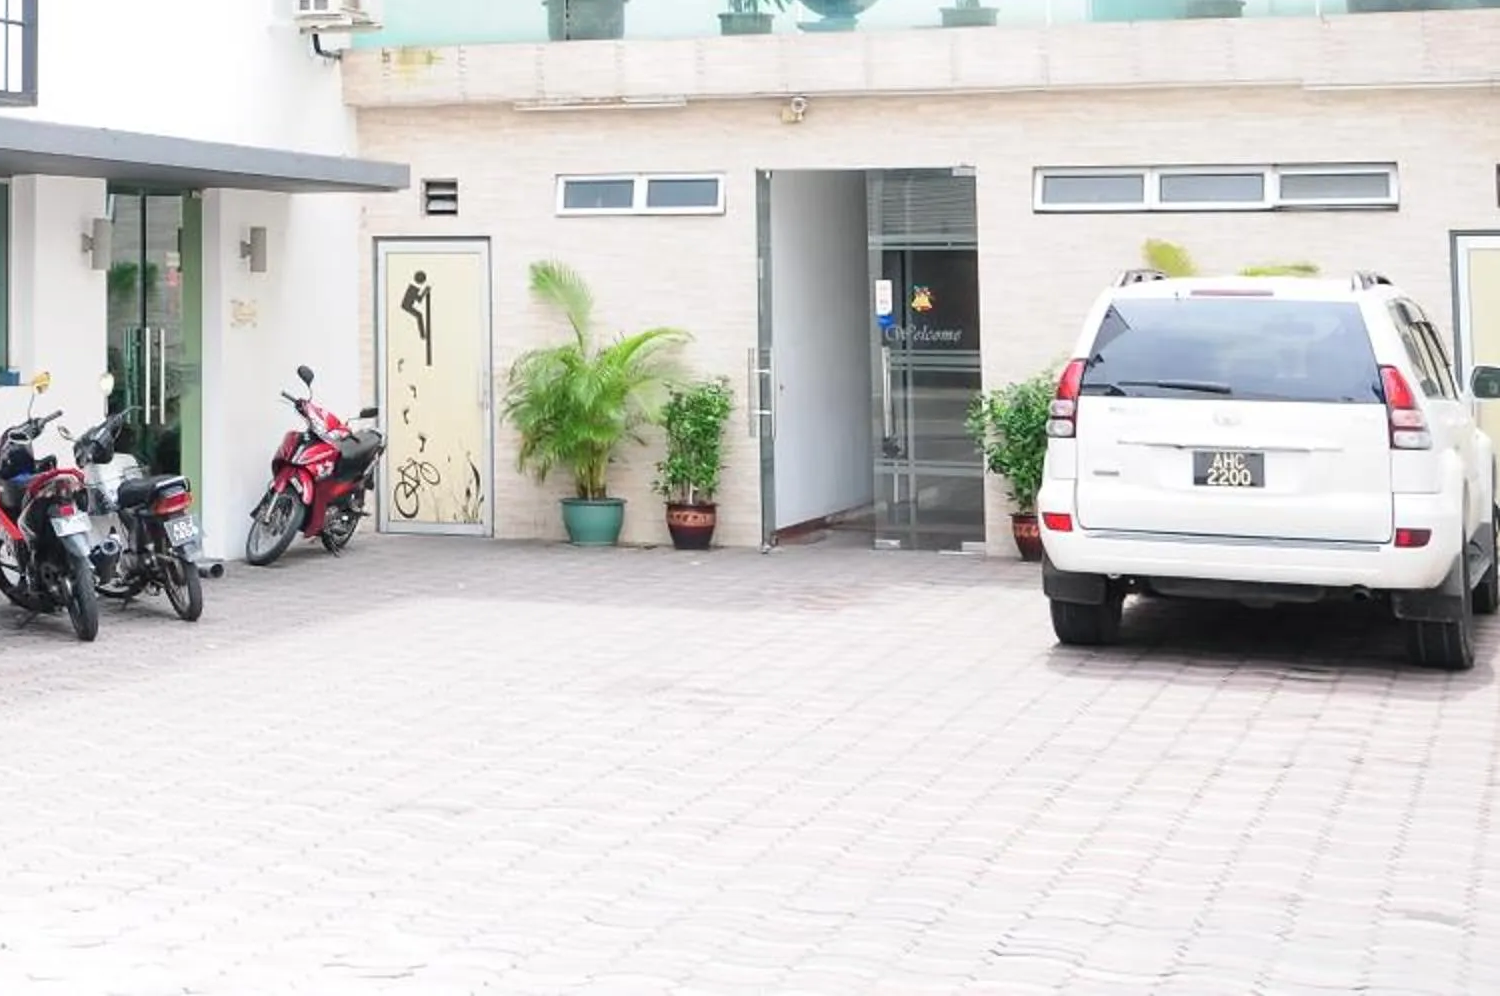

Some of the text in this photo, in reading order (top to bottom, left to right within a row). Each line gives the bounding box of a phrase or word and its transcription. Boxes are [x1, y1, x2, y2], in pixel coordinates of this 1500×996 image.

[884, 325, 962, 342] Welcome
[1213, 452, 1245, 469] AHC
[1206, 468, 1251, 485] 2200
